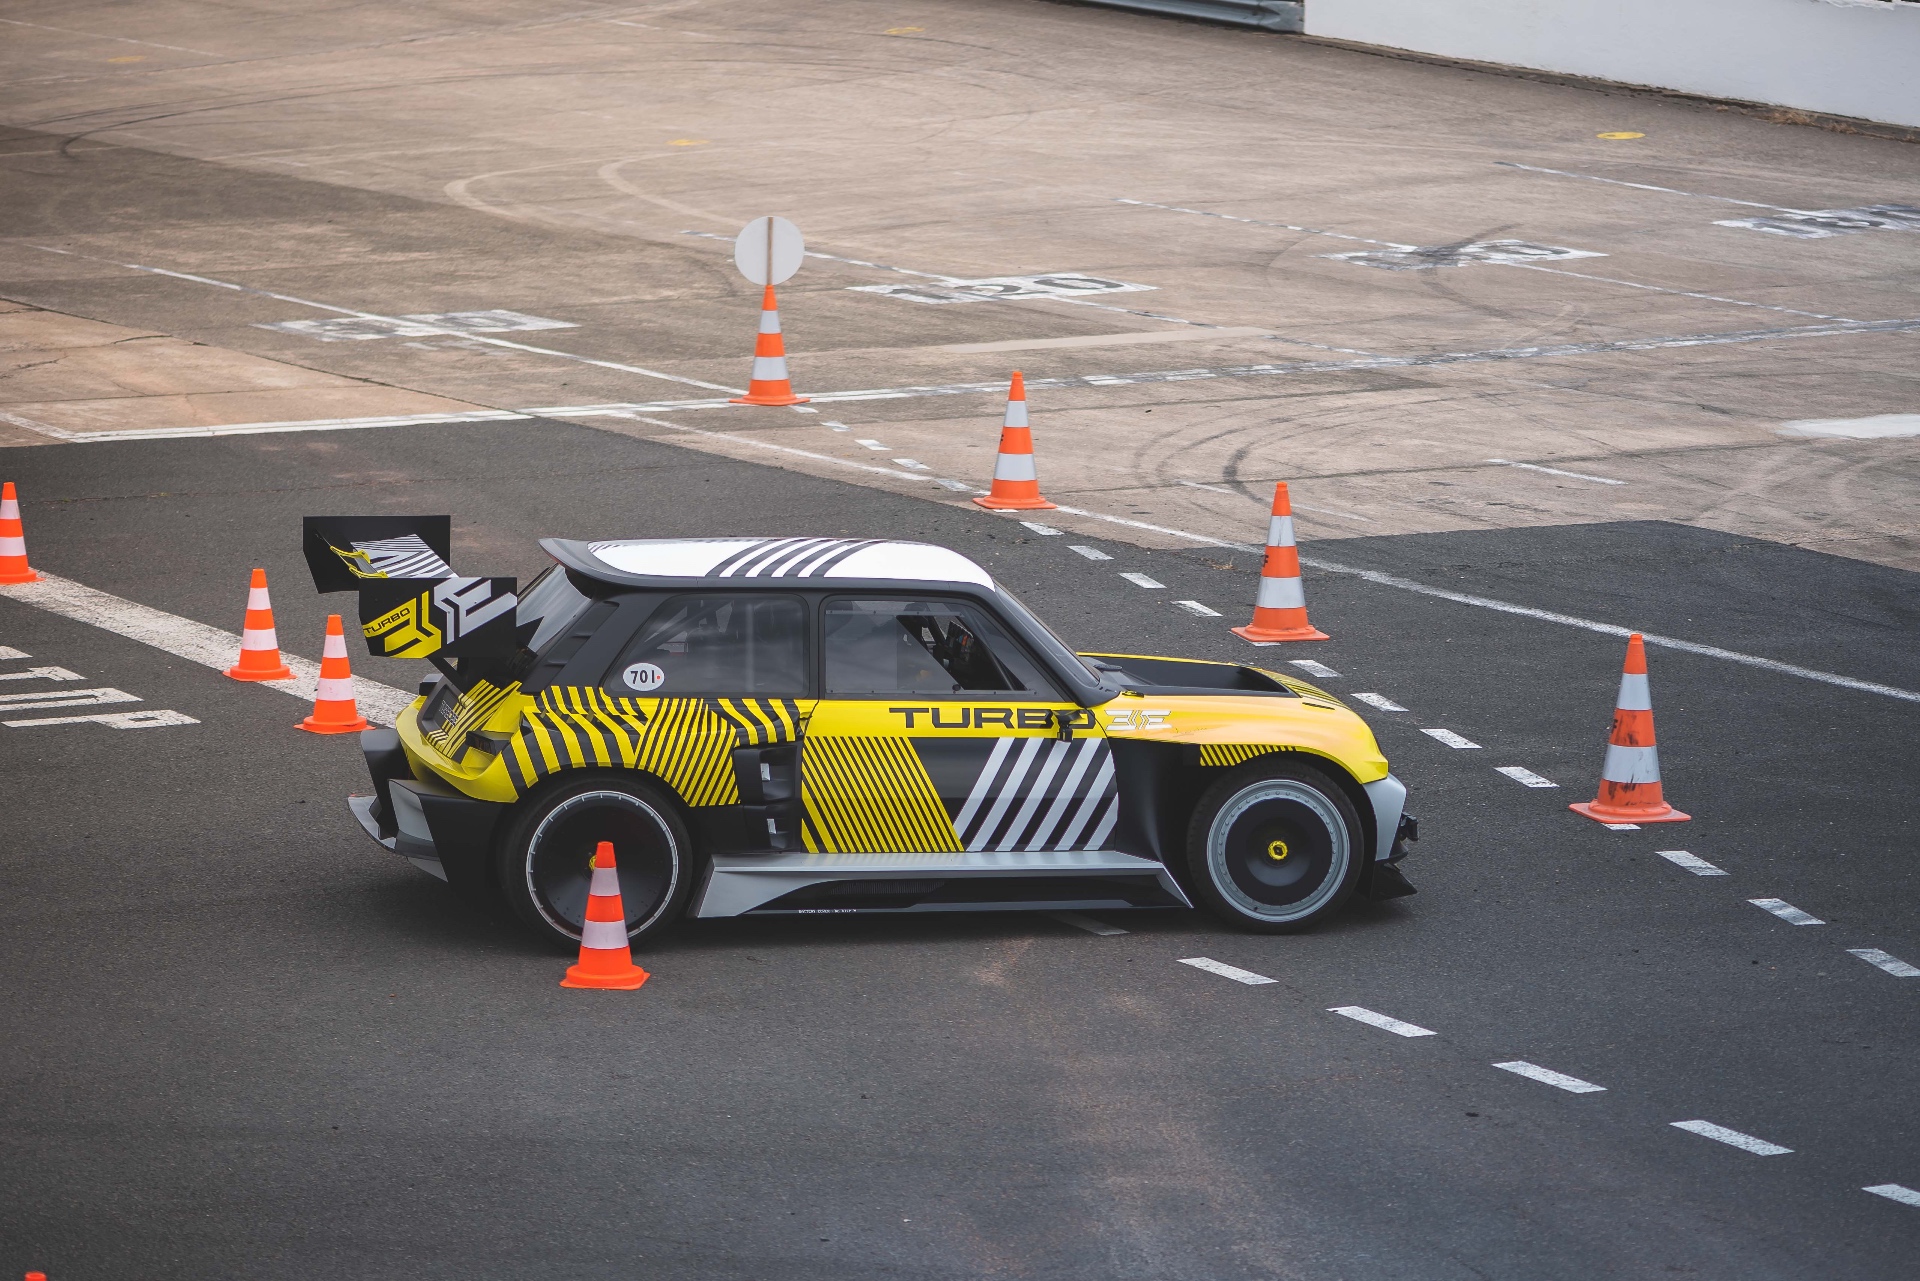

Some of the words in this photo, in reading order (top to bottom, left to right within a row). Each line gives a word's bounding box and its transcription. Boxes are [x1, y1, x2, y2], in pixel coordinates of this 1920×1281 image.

[887, 277, 1126, 299] 120
[362, 607, 411, 635] TURBO
[0, 645, 201, 730] TOP
